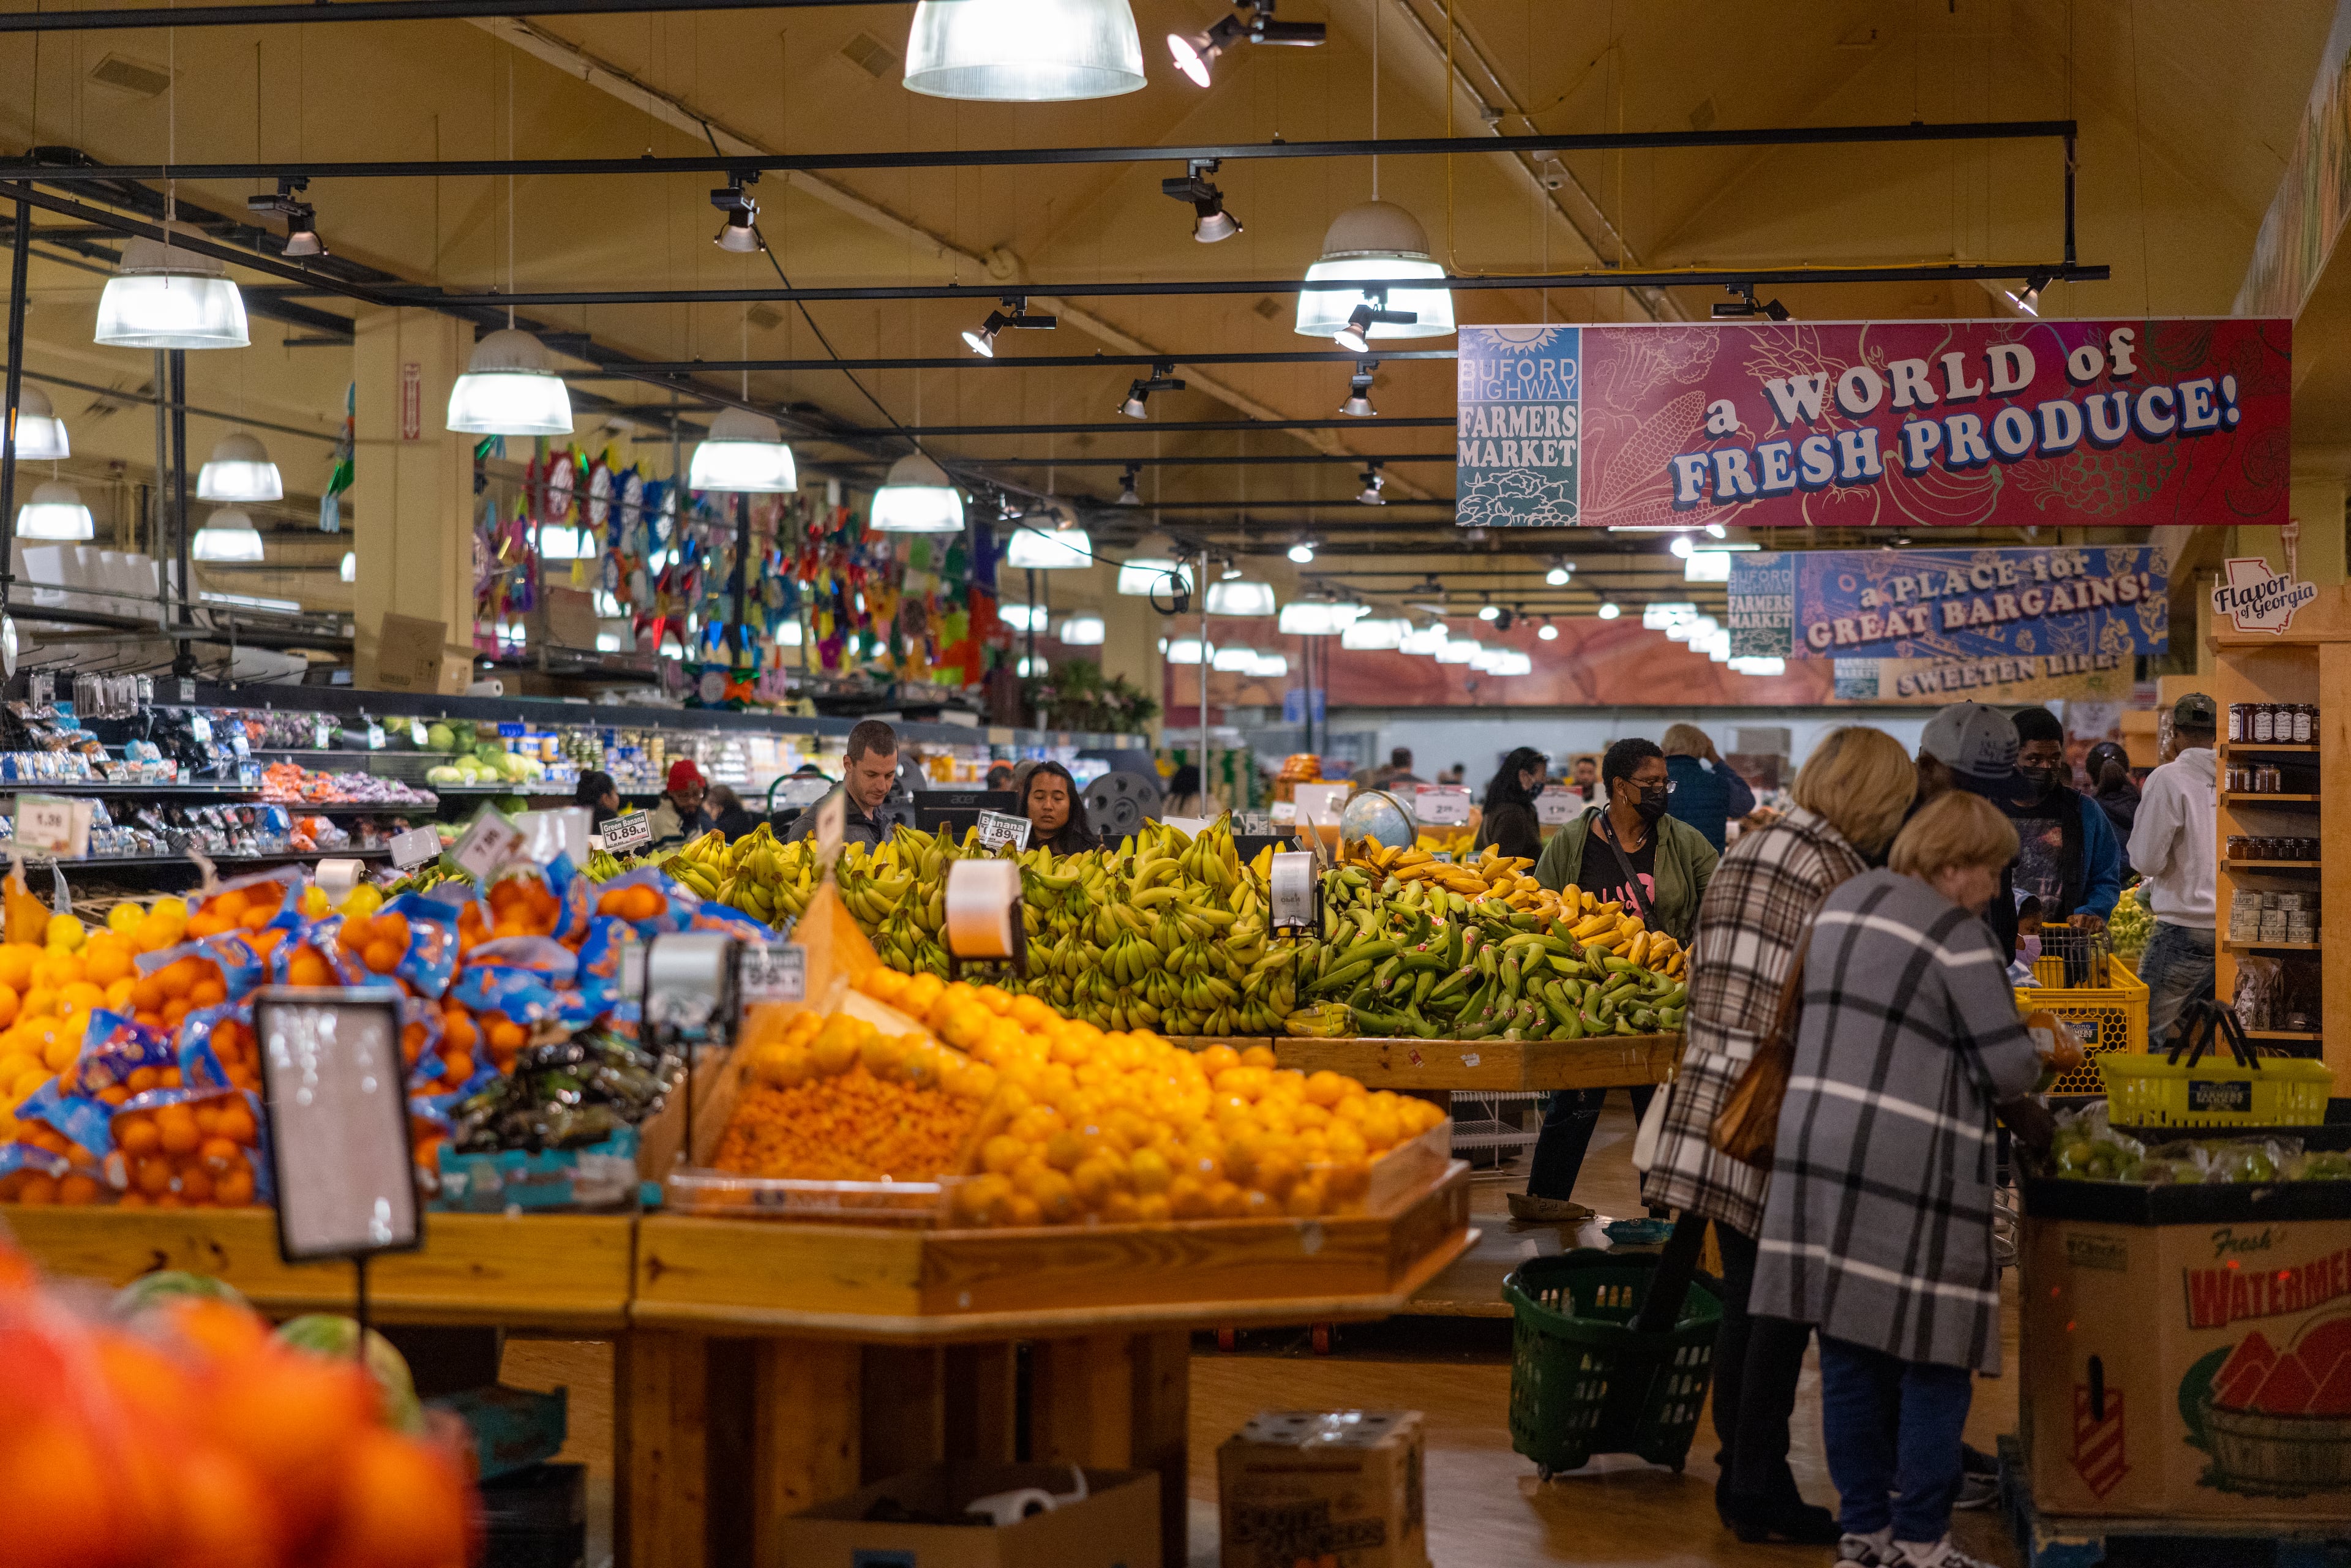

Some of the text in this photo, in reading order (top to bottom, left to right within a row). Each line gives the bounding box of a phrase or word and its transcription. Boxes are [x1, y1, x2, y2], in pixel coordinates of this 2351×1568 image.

[1460, 359, 1577, 380] BUFORD
[1704, 327, 2137, 436] a WORLD of
[1460, 379, 1577, 400] HIGHWAY
[1458, 405, 1577, 438] FARMERS
[1458, 440, 1577, 467] MARKET
[1670, 374, 2241, 508] FRESH PRODUCE!
[1729, 570, 1791, 582] BUFORD
[1861, 554, 2090, 609] a PLACE for
[1728, 595, 1792, 613] FARMERS
[2214, 575, 2289, 612] Flavor
[2241, 585, 2314, 619] of Georgia
[1728, 613, 1791, 629] MARKET
[1807, 571, 2151, 651] GREAT BARGAINS!
[1897, 658, 2036, 696] SWEETEN
[951, 795, 978, 804] acer
[603, 823, 622, 832] Green
[622, 816, 645, 827] Banana
[981, 816, 1024, 831] Banana
[2211, 1226, 2272, 1258] Fresh
